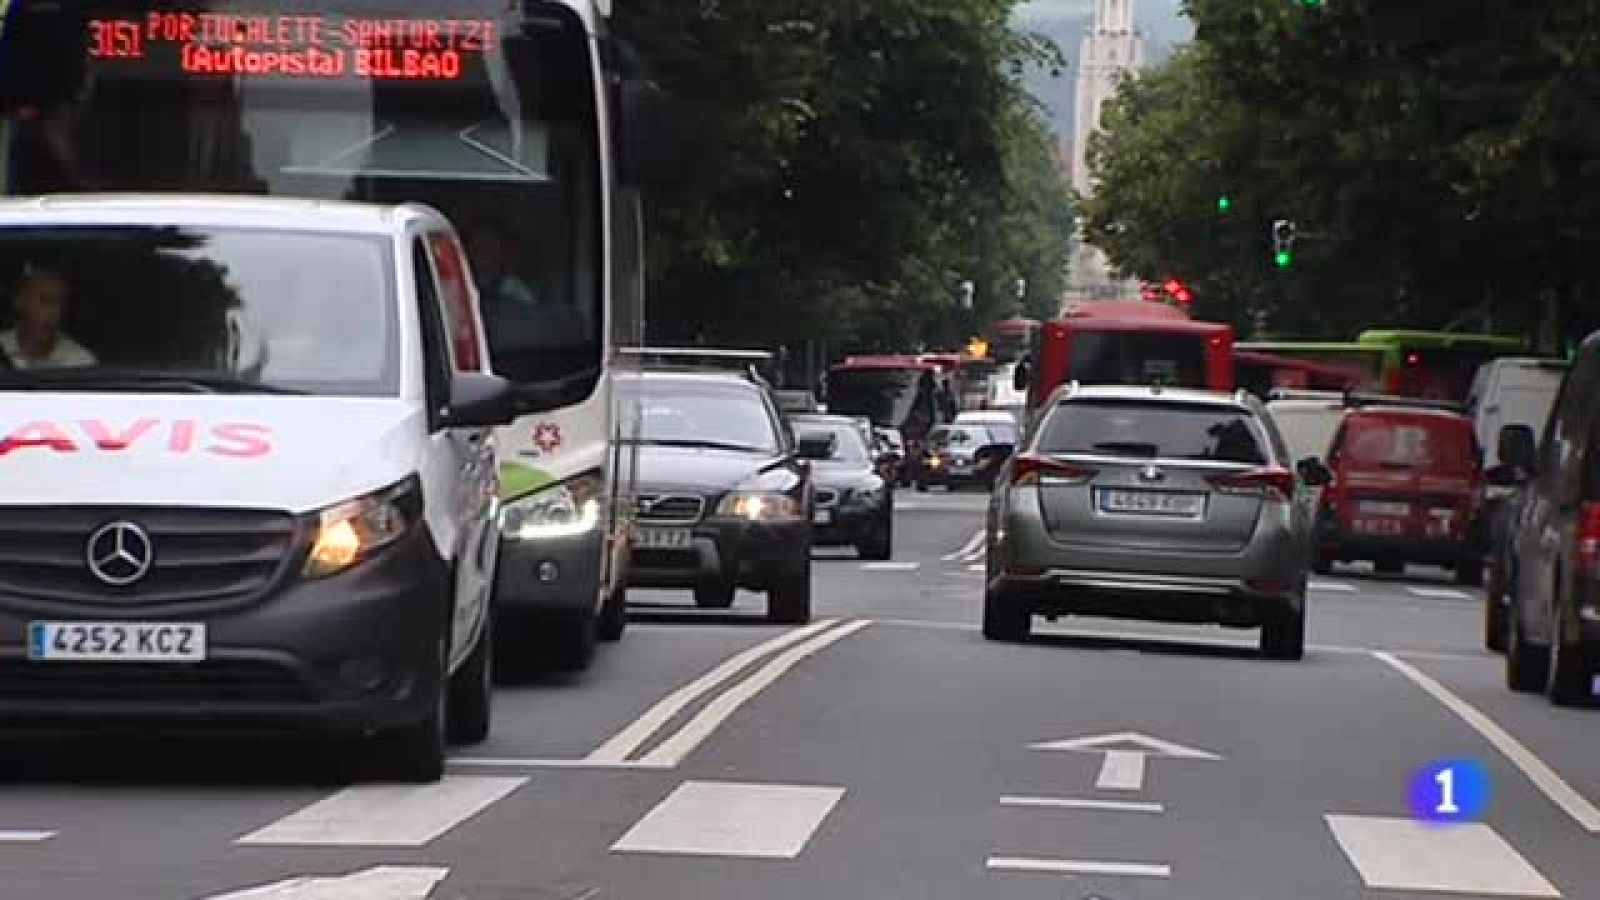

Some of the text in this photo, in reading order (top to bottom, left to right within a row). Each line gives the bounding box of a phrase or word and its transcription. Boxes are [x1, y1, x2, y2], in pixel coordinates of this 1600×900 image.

[88, 19, 143, 57] 3151
[182, 43, 460, 77] (Autopista) BILBAO
[0, 418, 274, 458] AVIS
[53, 627, 194, 655] 4252 KCZ
